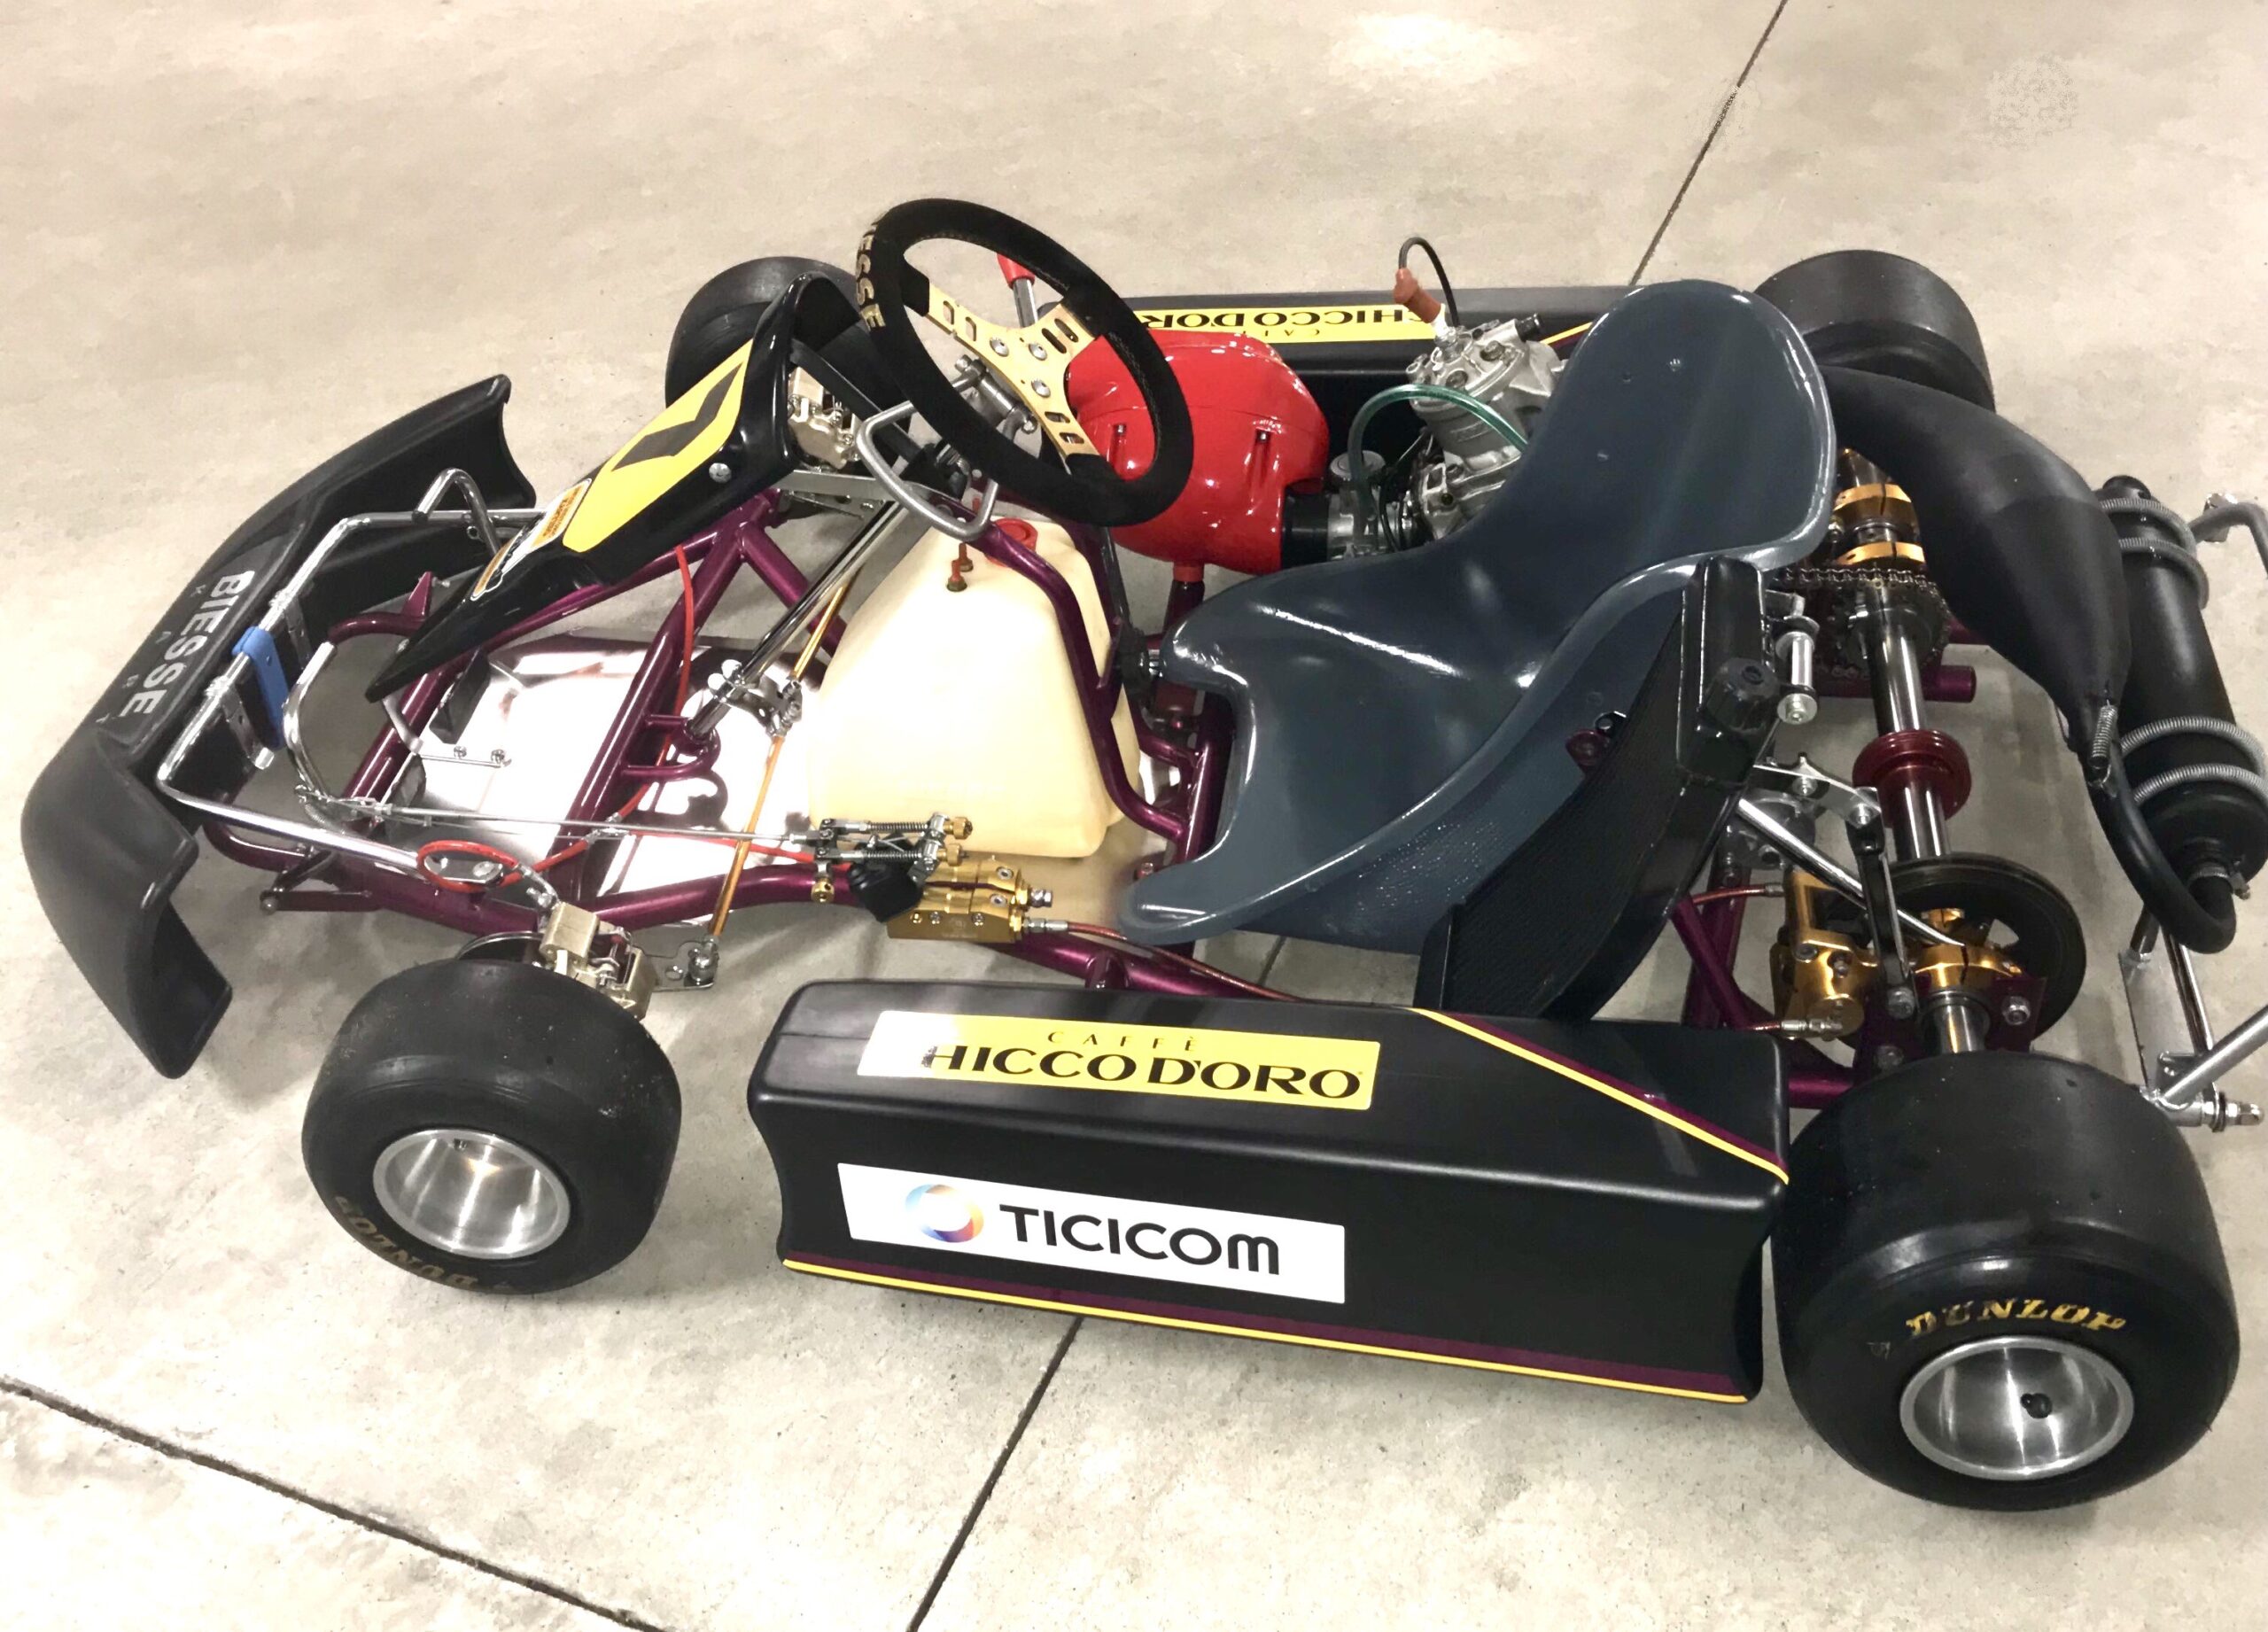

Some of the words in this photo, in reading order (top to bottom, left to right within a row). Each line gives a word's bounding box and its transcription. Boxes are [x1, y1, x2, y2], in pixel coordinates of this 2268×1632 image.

[1141, 312, 1246, 329] D'OR
[120, 571, 255, 717] BIESSE
[1048, 1030, 1196, 1052] CAFFÈ
[920, 1045, 1137, 1081] HICCO
[1147, 1058, 1361, 1099] D'ORO
[1906, 1297, 2126, 1337] DUNLOP
